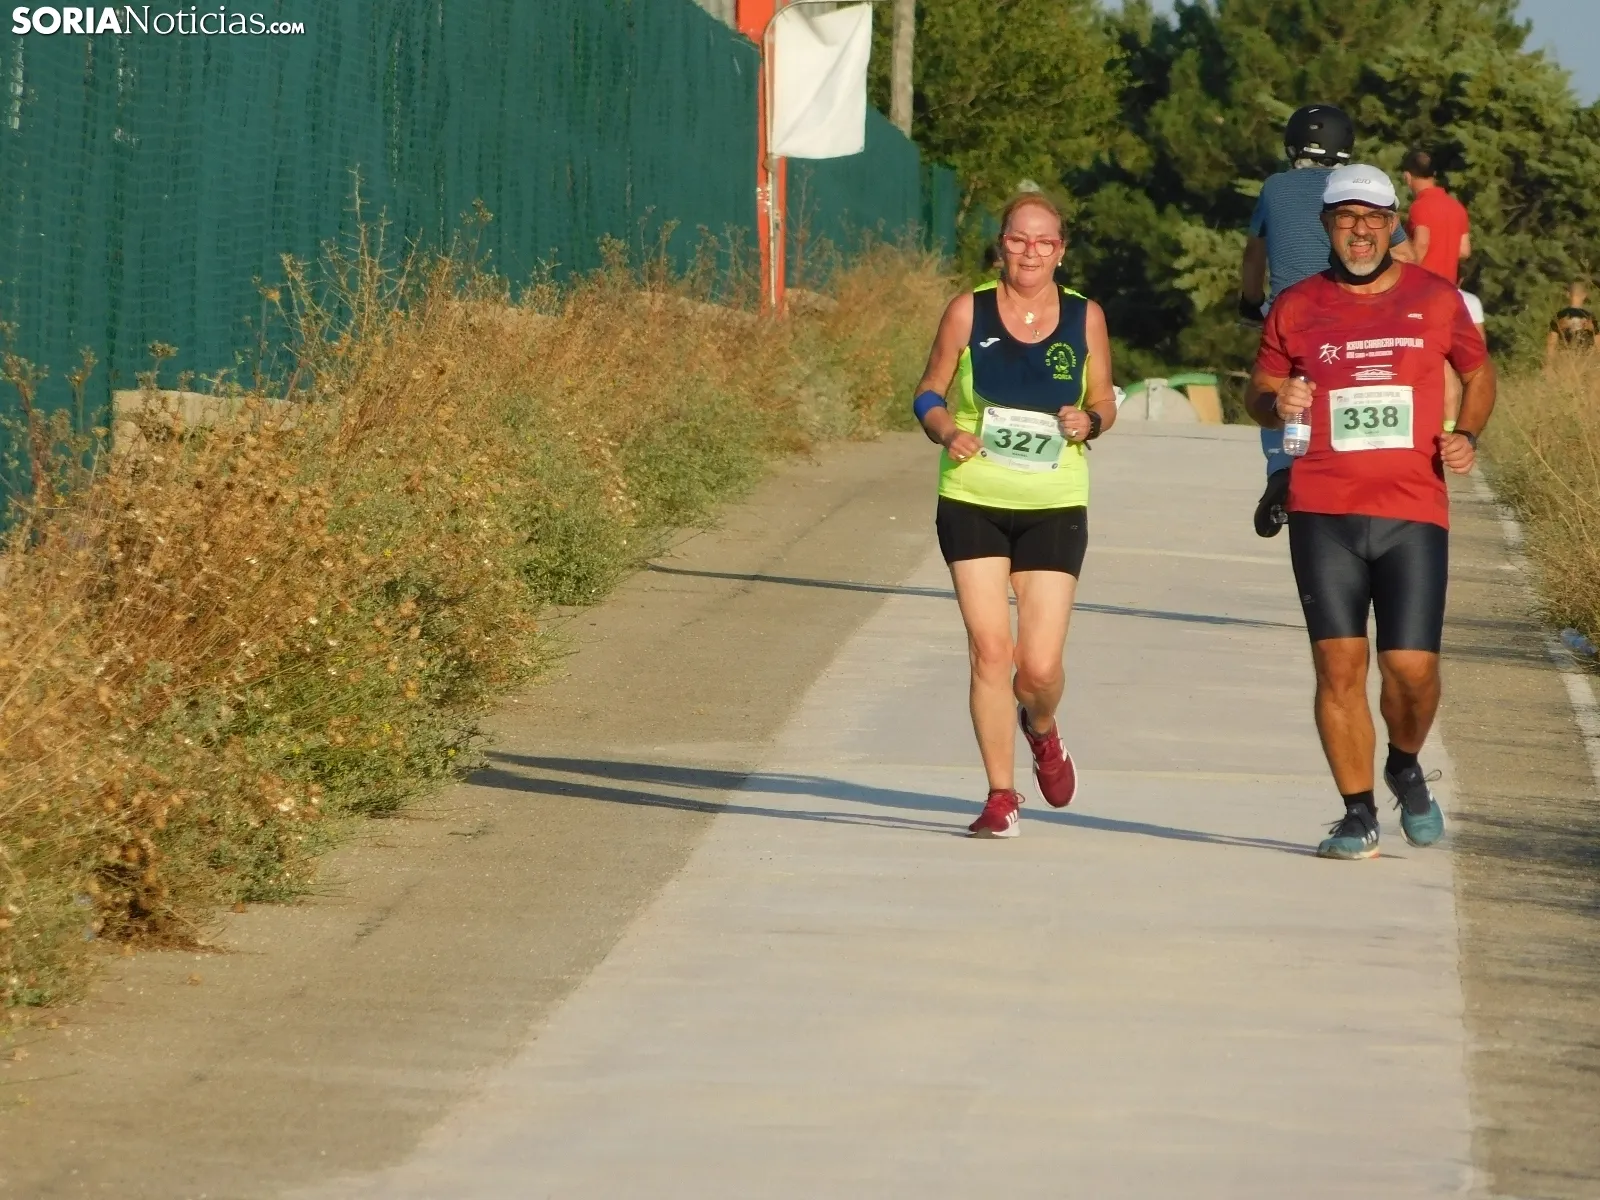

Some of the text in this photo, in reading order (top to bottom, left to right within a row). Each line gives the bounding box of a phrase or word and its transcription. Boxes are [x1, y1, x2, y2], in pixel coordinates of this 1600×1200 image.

[1364, 338, 1394, 349] CARRERA
[1395, 337, 1424, 348] POPULAR
[1344, 406, 1398, 430] 338
[994, 428, 1052, 454] 327
